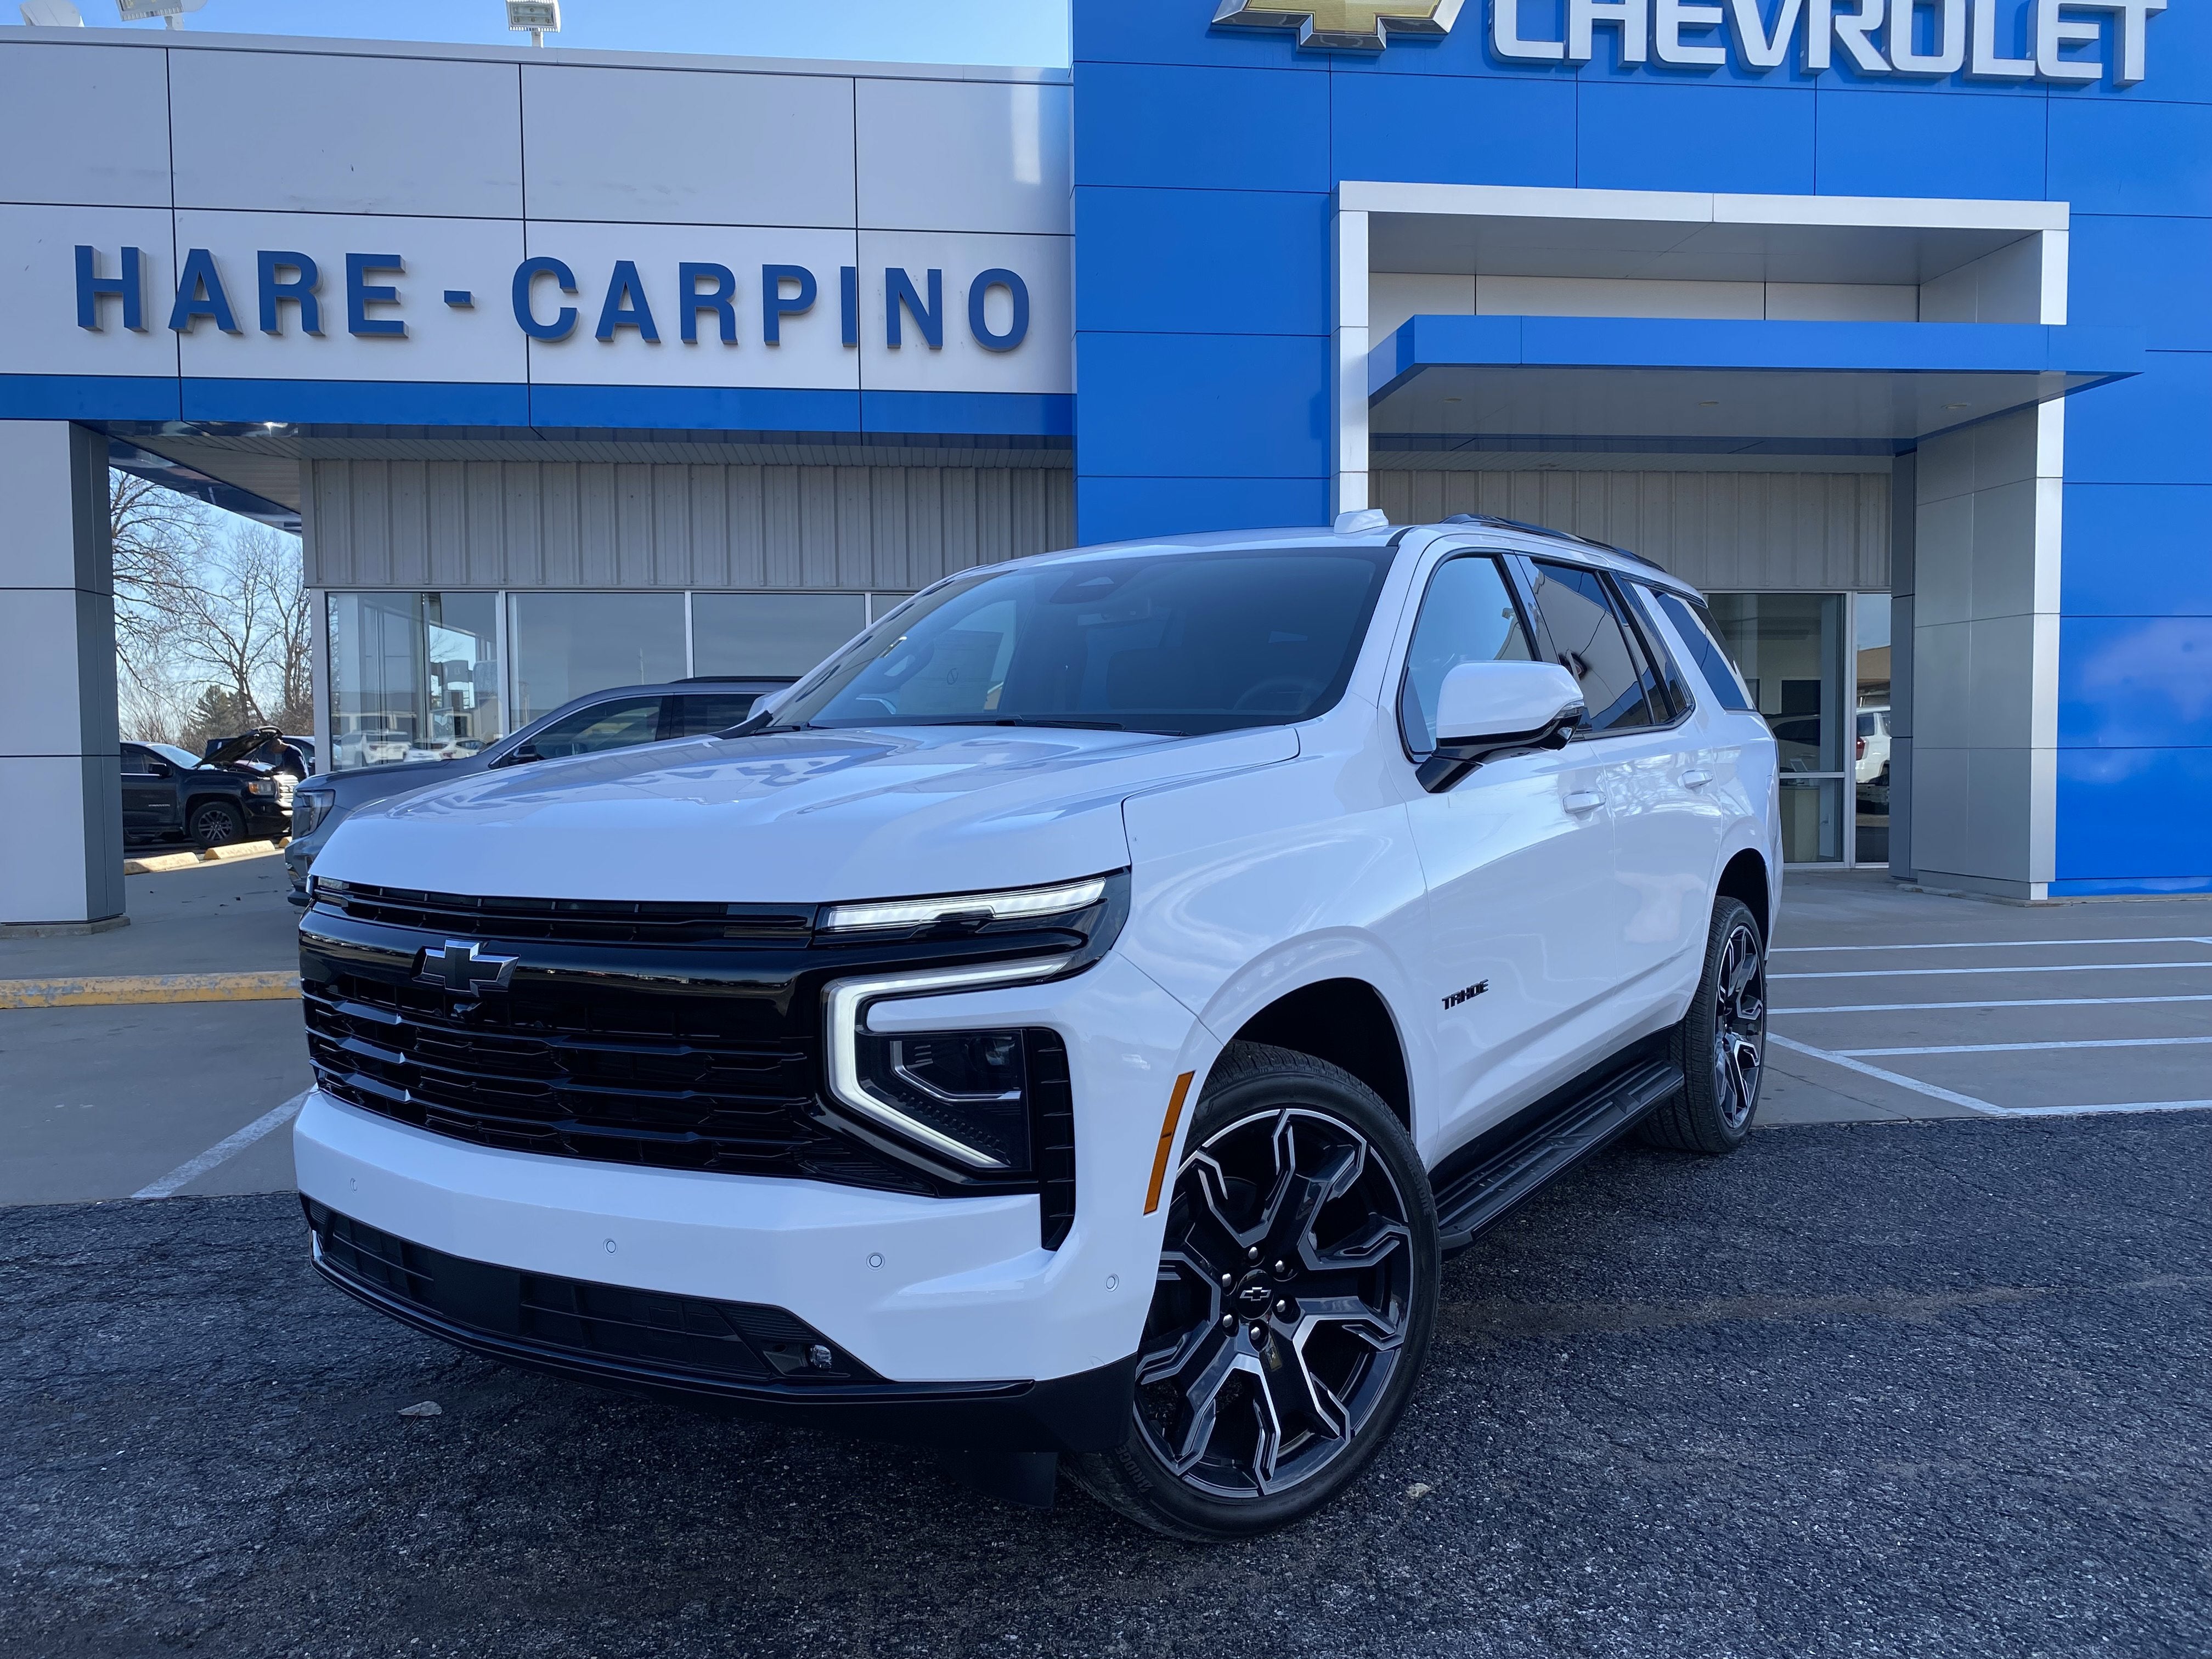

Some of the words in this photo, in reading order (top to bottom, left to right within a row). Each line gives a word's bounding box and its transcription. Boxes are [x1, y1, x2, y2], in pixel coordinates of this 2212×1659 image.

[1488, 0, 2168, 86] CHEVROLET
[75, 245, 409, 338] HARE
[512, 257, 1029, 352] CARPINO
[1441, 978, 1489, 1010] TAHOE
